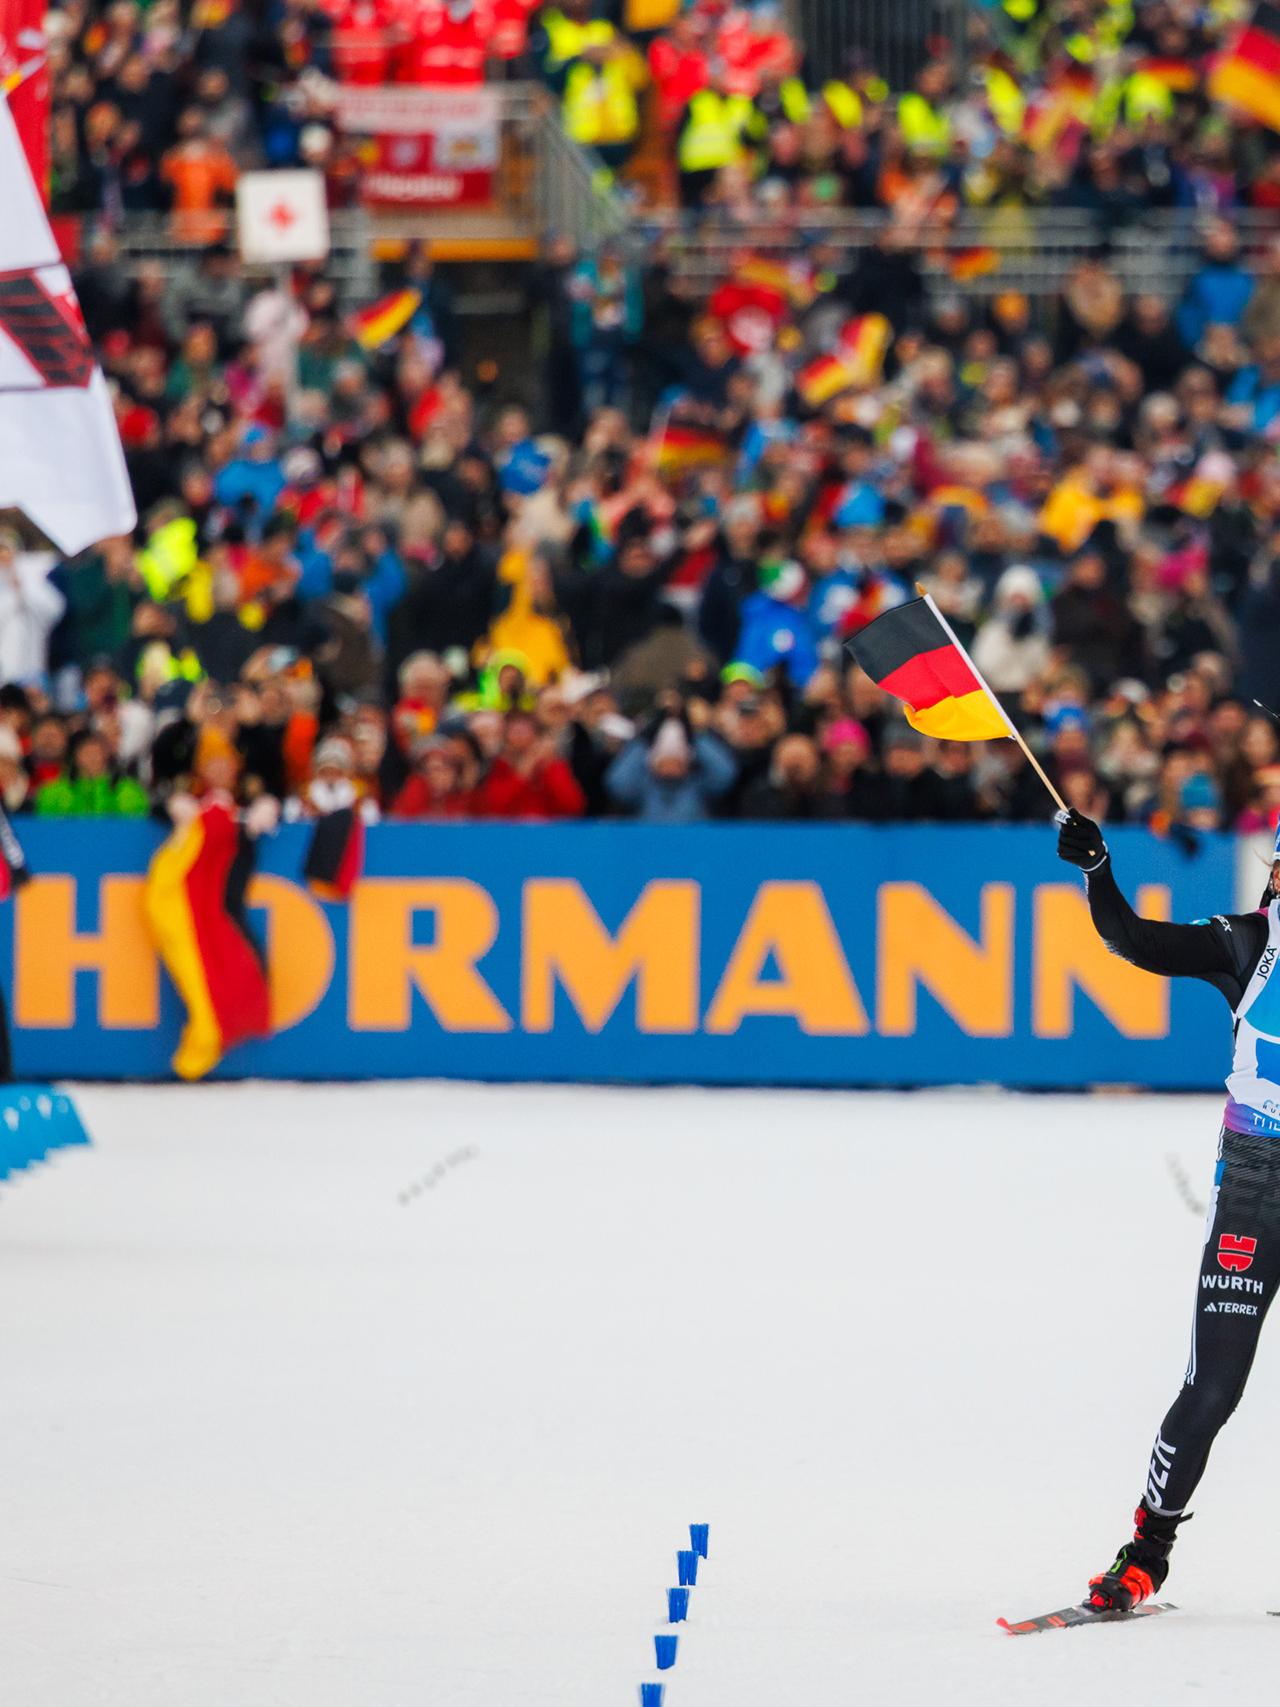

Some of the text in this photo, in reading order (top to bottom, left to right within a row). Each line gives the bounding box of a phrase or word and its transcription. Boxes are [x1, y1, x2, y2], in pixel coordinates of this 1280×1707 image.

[1257, 946, 1277, 980] JOKA
[1201, 1274, 1264, 1295] WÜRTH
[1218, 1302, 1258, 1316] TERREX
